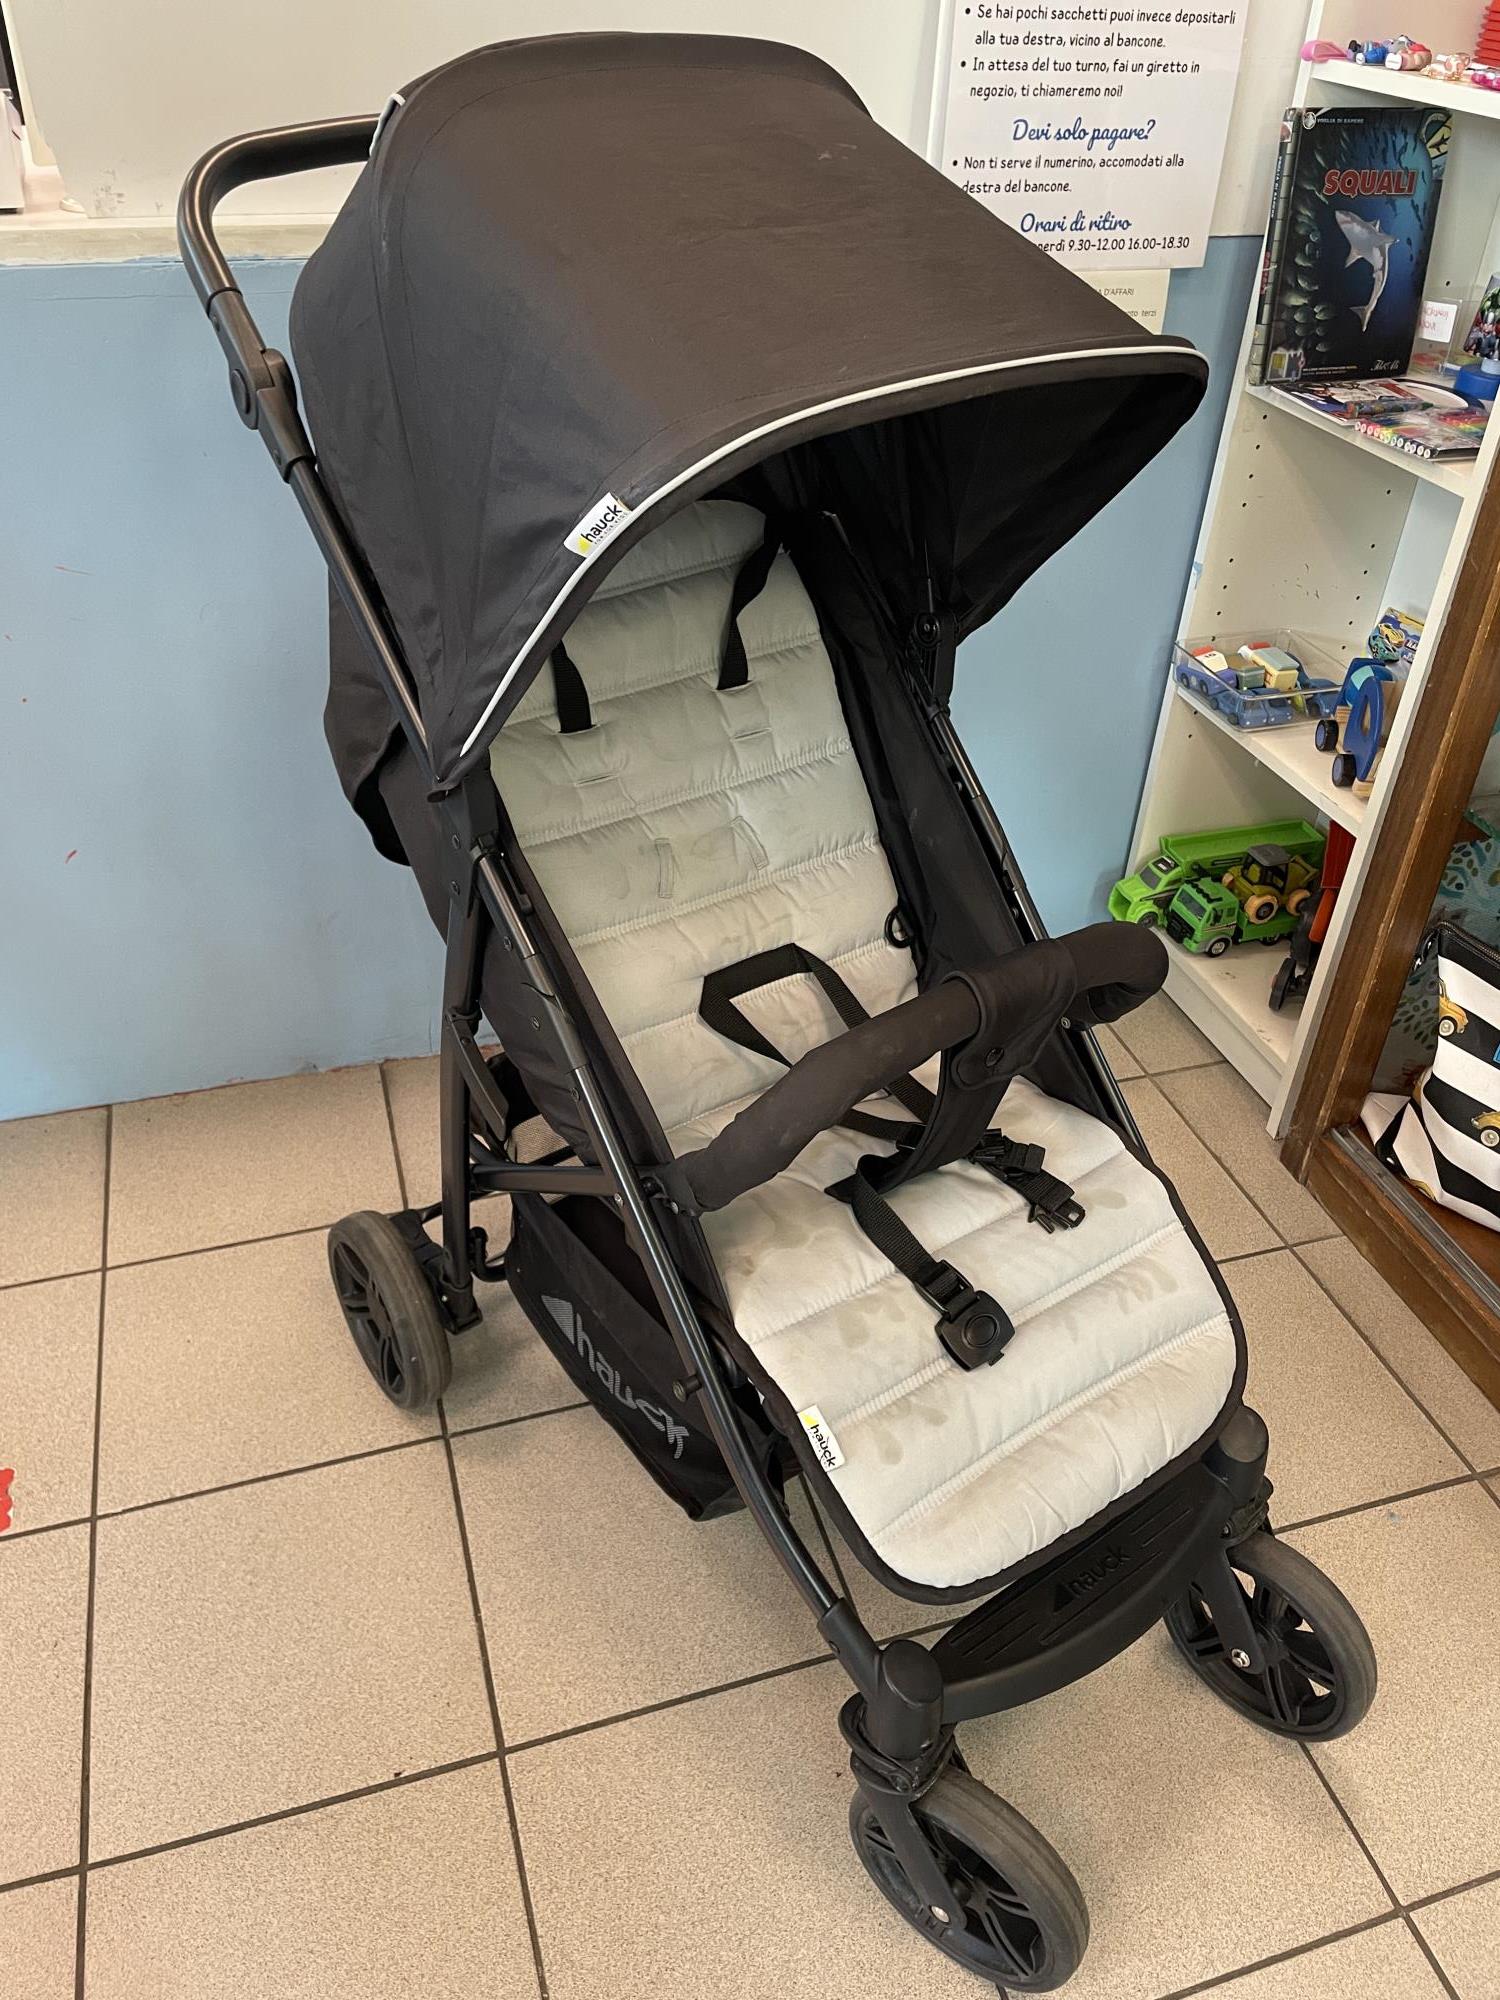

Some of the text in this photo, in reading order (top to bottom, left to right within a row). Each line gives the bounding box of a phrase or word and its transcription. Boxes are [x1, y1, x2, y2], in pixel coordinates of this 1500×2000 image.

[977, 4, 1236, 26] Se hai pochi sacchetti puoi invece depositarli
[975, 30, 1166, 48] alla tua destra, vicino al bancone.
[972, 57, 1200, 77] In attesa del tuo turno, fai un giretto in
[970, 83, 1123, 101] negozio, ti chiameremo noi!
[1013, 117, 1156, 151] Devi solo pagare?
[964, 154, 1184, 169] Non ti serve il numerino, accomodati alla
[962, 179, 1072, 194] destra del bancone.
[1323, 168, 1418, 199] SQUALI
[1020, 210, 1132, 232] Orari di ritiro
[1037, 237, 1190, 251] nerdì 9.30-12.00 16.00-18.30
[581, 504, 622, 543] hauck
[576, 1312, 690, 1459] hauck
[810, 1424, 836, 1467] hauck
